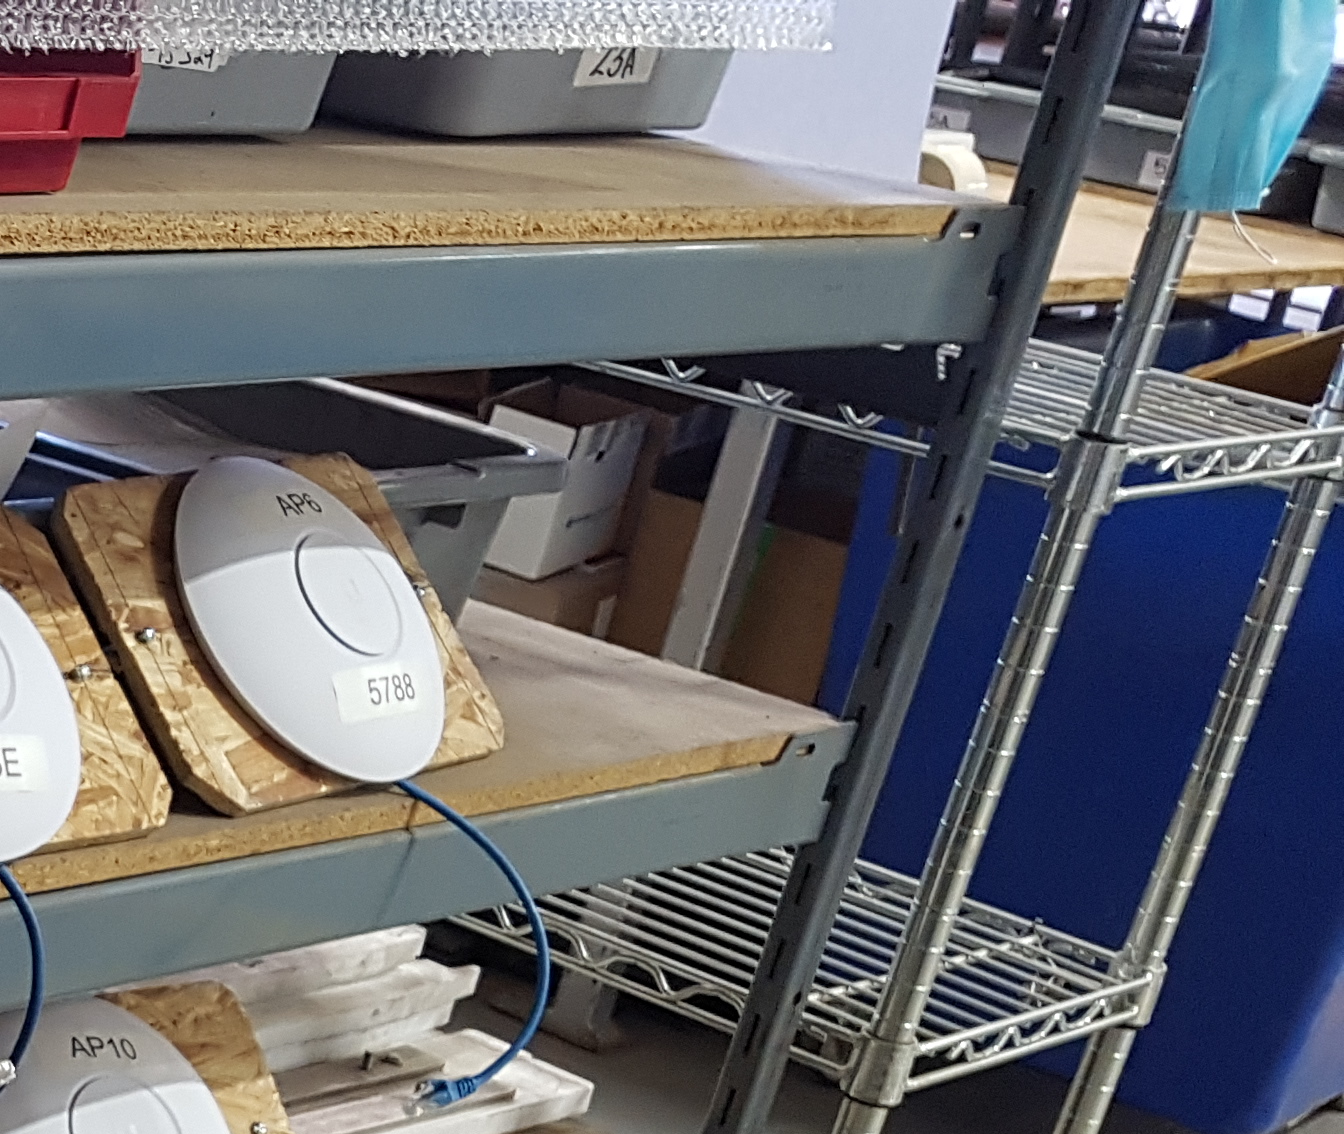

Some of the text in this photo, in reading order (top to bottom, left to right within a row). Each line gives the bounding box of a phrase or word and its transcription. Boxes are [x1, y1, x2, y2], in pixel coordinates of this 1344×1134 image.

[276, 493, 323, 517] AP6
[367, 673, 415, 705] 5788
[71, 1036, 137, 1060] AP10
